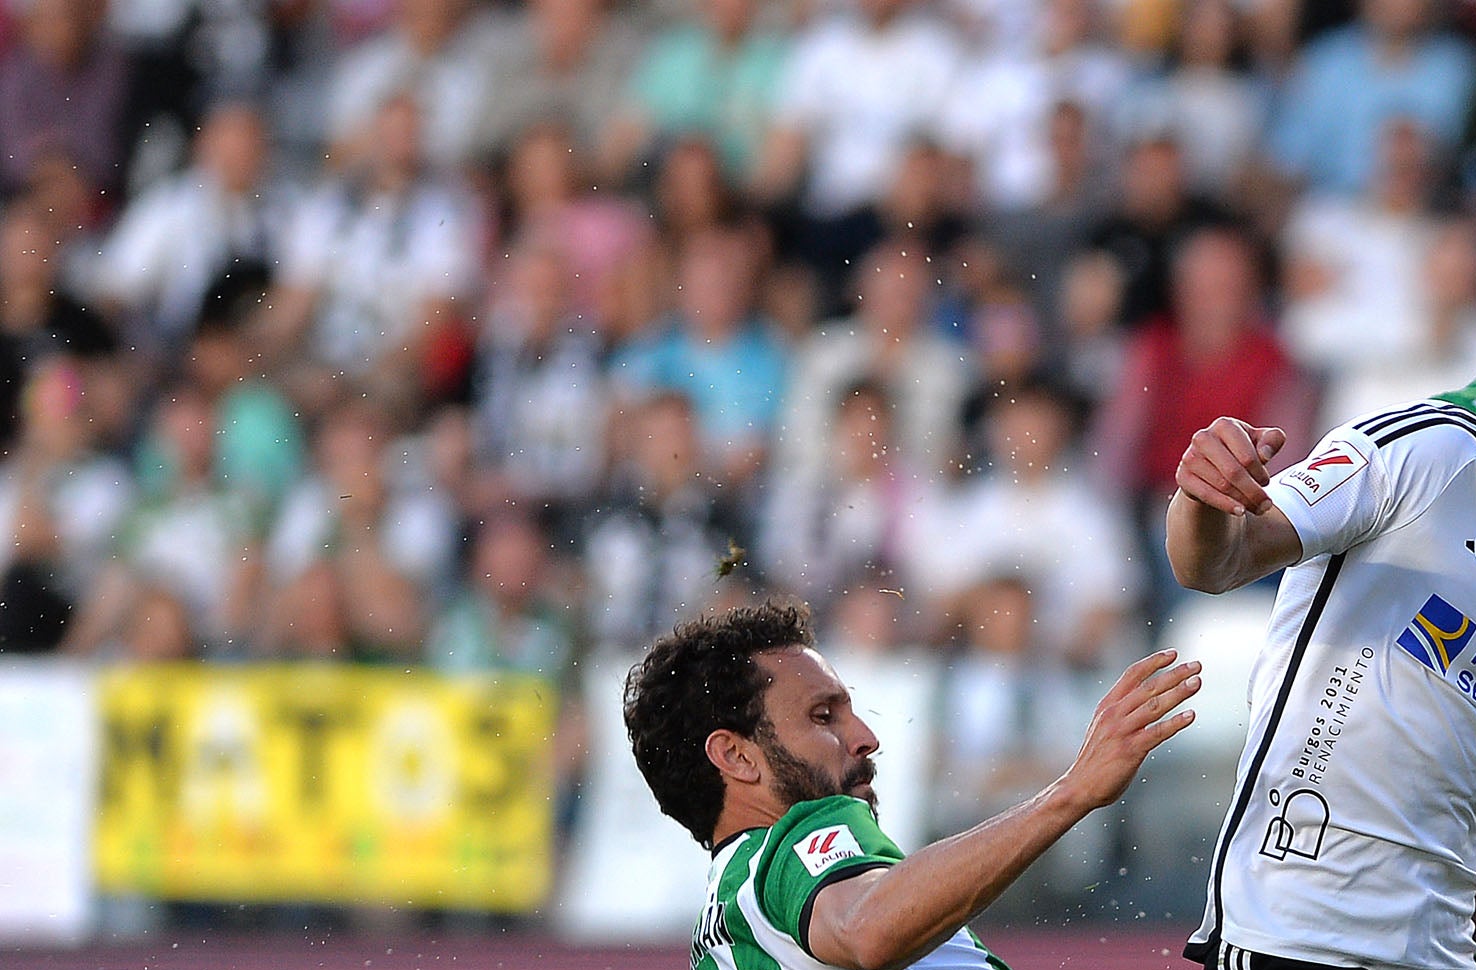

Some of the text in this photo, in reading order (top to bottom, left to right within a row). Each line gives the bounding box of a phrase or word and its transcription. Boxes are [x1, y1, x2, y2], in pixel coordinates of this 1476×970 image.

[1292, 665, 1349, 778] Burgos 2031
[1307, 646, 1375, 785] RENACIMIENTO
